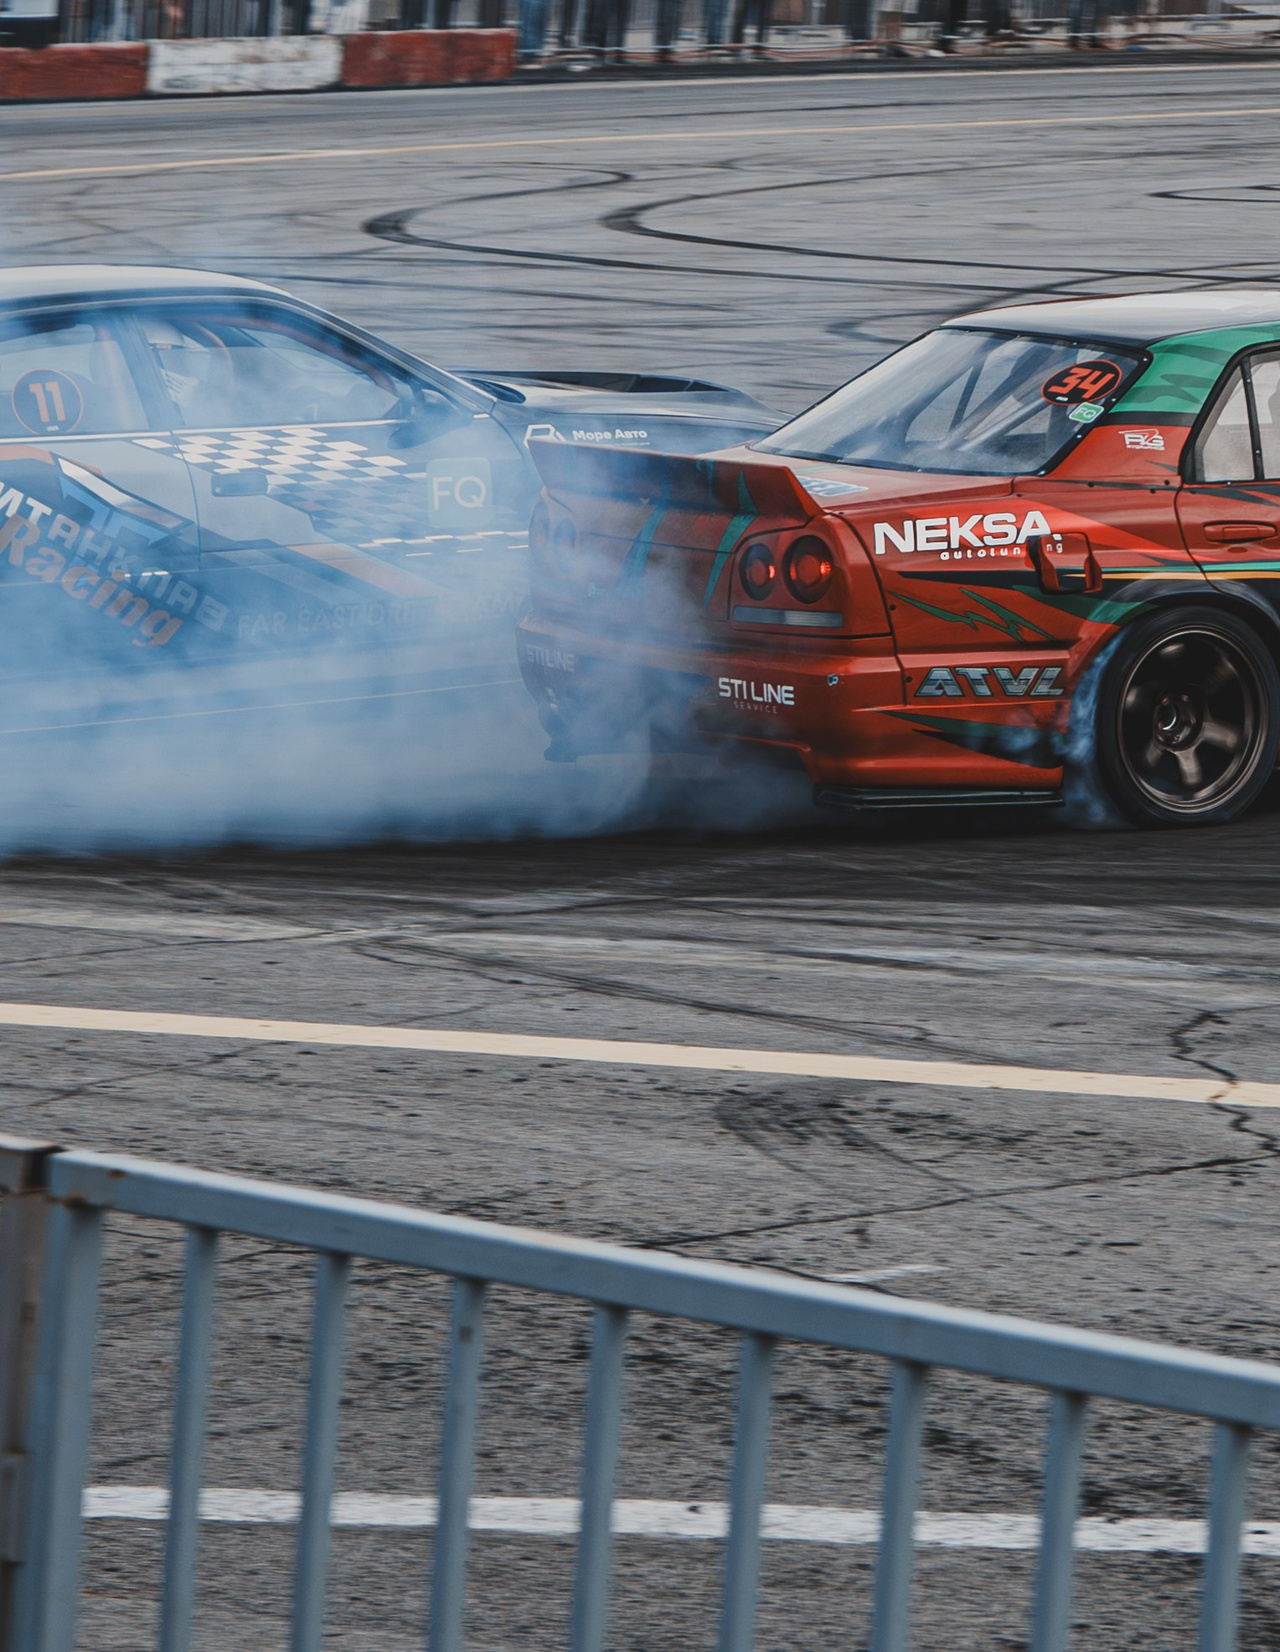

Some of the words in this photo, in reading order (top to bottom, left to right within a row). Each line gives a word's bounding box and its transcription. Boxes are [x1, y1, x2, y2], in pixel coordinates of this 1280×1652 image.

[1047, 367, 1115, 399] 34
[29, 381, 66, 422] 11
[572, 430, 612, 442] Море
[615, 429, 648, 439] Авто
[432, 475, 487, 510] FQ
[873, 510, 1063, 554] NEKSA
[940, 543, 1063, 561] autotunng
[0, 513, 184, 648] Racing
[734, 701, 778, 714] SERVICE
[751, 681, 795, 706] LINE
